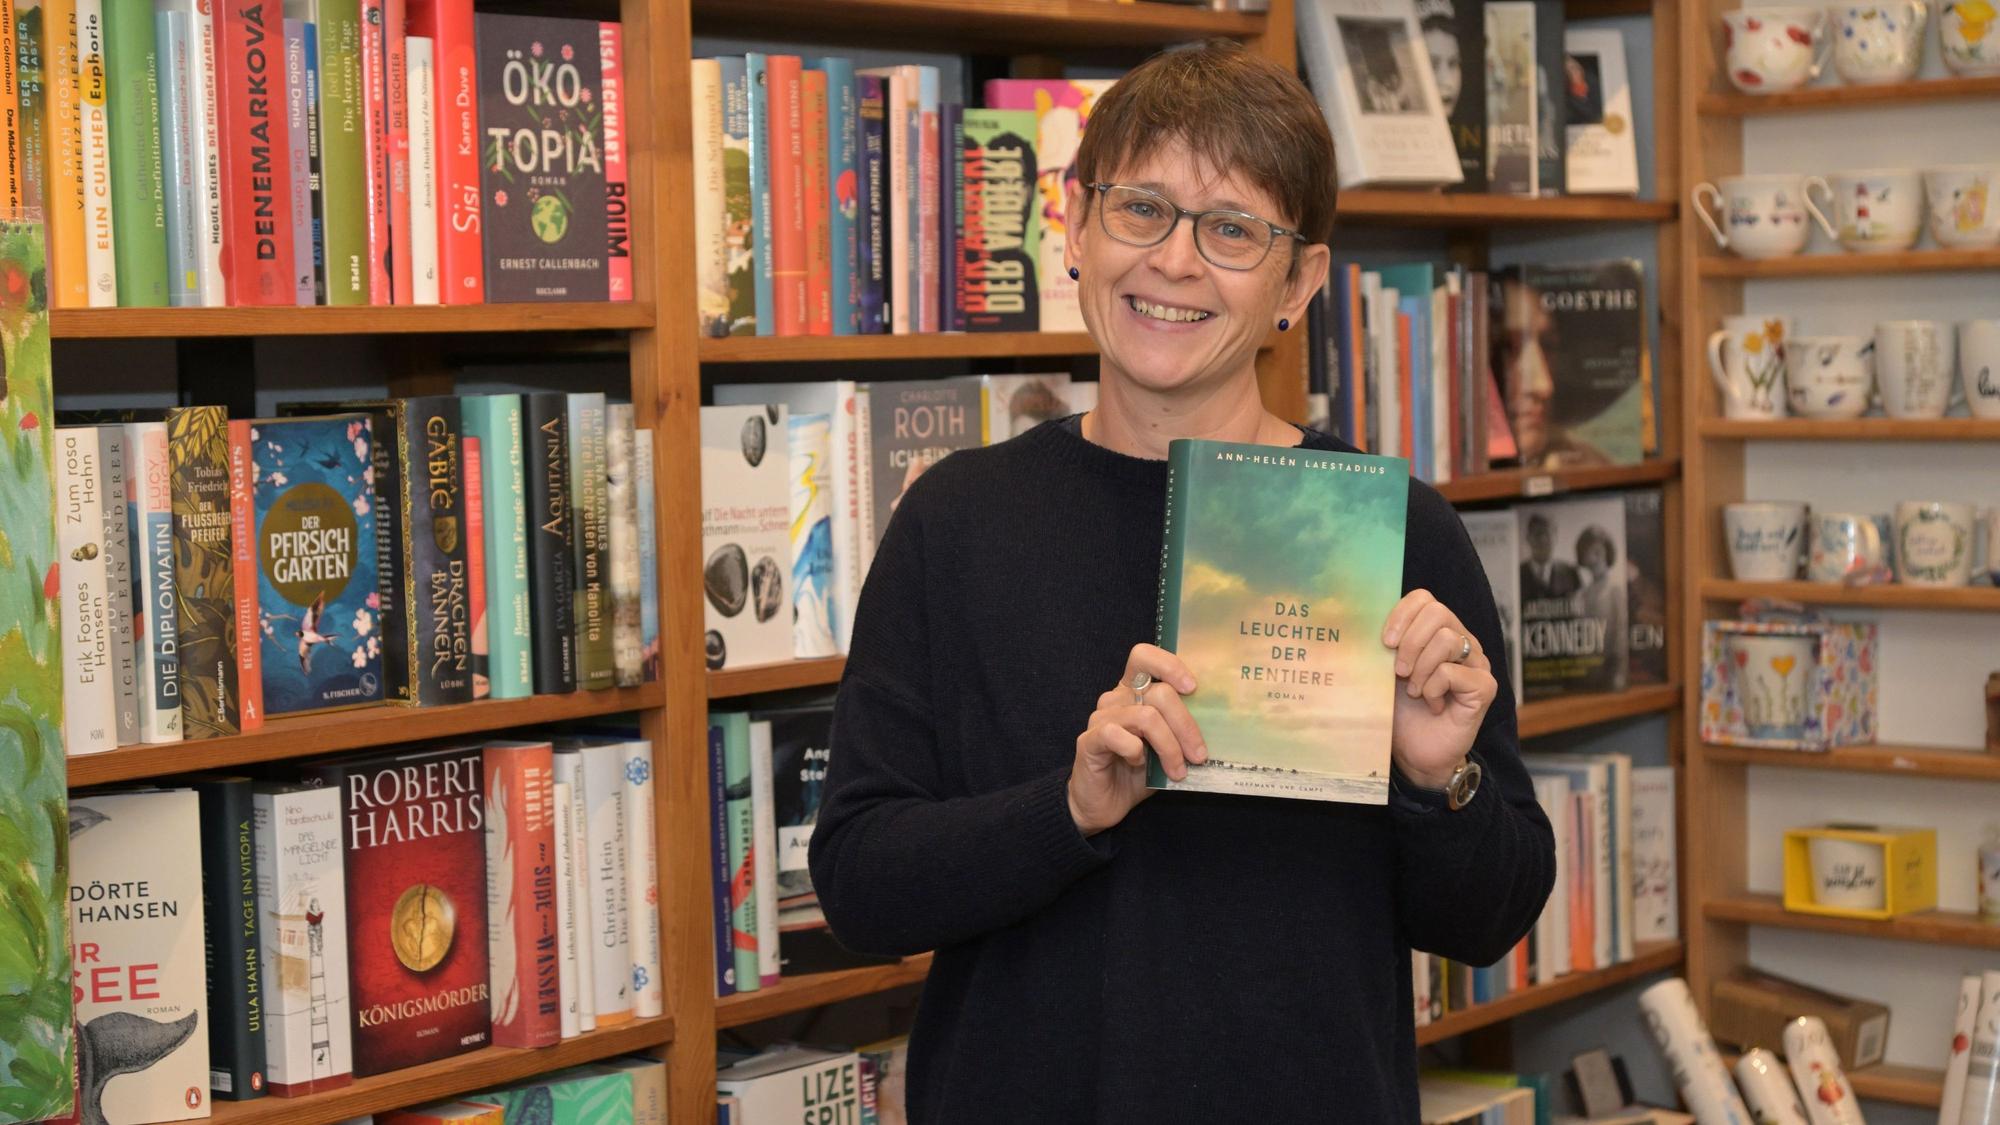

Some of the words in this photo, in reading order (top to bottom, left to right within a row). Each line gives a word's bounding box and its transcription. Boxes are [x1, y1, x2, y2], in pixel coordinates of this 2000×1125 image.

[19, 21, 30, 77] PAPIER
[69, 12, 80, 89] HERZEN
[85, 14, 102, 100] Euphorie
[176, 39, 187, 71] Herz
[203, 23, 214, 72] NARREN
[325, 19, 338, 69] Dicker
[340, 20, 352, 53] Tage
[599, 28, 616, 71] LISA
[30, 39, 40, 93] PALAST
[57, 45, 70, 119] CROSSAN
[146, 52, 157, 94] Glück
[289, 37, 300, 85] Nicola
[341, 56, 354, 105] letzten
[371, 31, 381, 102] GESICHTER
[391, 52, 403, 105] TOCHTER
[502, 49, 582, 107] ÖKO
[22, 81, 31, 107] DER
[205, 75, 215, 125] HEILIGEN
[326, 72, 339, 98] Joël
[456, 66, 471, 107] Duve
[788, 79, 801, 128] ÜBUNG
[6, 107, 14, 125] Das
[150, 97, 159, 123] von
[178, 74, 191, 155] synthetische
[290, 87, 302, 129] Denis
[342, 107, 355, 133] Die
[392, 107, 403, 129] DIE
[600, 78, 621, 164] ECKHART
[61, 127, 73, 177] SARAH
[91, 109, 106, 197] CULLHED
[206, 128, 216, 147] DIE
[239, 2, 277, 261] DENEMARKOVÁ
[457, 111, 473, 156] Karen
[488, 127, 602, 174] TOPIA
[790, 130, 802, 156] DIE
[25, 136, 33, 182] MIRANDA
[73, 103, 84, 211] VERHEIZTE
[150, 126, 162, 201] Definition
[182, 158, 192, 185] Das
[208, 154, 219, 199] DELIBES
[9, 174, 17, 192] mit
[309, 171, 320, 191] SIE
[375, 184, 384, 214] TOVE
[531, 175, 567, 186] ROMAN
[869, 159, 881, 212] APOTHEKE
[96, 206, 109, 250] ELIN
[155, 203, 164, 229] Die
[210, 202, 220, 244] MIGUEL
[451, 182, 480, 235] Sisi
[499, 258, 538, 270] ERNEST
[539, 258, 600, 270] CALLENBACH
[871, 213, 882, 281] VERSTECKTE
[350, 254, 360, 292] PIPER
[1542, 288, 1638, 313] GOETHE
[508, 408, 520, 467] Chemie
[581, 408, 594, 430] Die
[893, 405, 966, 440] ROTH
[64, 437, 79, 476] rosa
[426, 415, 454, 511] GABLÉ
[447, 432, 459, 497] REBECCA
[582, 435, 596, 464] drei
[593, 408, 607, 484] ALMUDENA
[889, 448, 920, 468] ICH
[1216, 451, 1297, 467] ANN-HELÉN
[1304, 460, 1387, 475] LAESTADIUS
[80, 454, 95, 504] Hahn
[147, 458, 162, 511] LUCY
[159, 438, 172, 511] FRICKE
[187, 480, 228, 493] Friedrich
[193, 465, 222, 479] Tobias
[231, 445, 249, 500] years
[510, 468, 520, 495] der
[540, 417, 564, 536] AQUITANIA
[846, 431, 858, 520] BEIFANG
[65, 482, 83, 525] Zum
[110, 442, 125, 548] ANDERER
[199, 501, 212, 511] DER
[583, 469, 598, 549] Hochzeiten
[713, 508, 729, 521] Die
[730, 507, 756, 520] Nacht
[1164, 468, 1176, 534] RENTIERE
[190, 527, 227, 543] PFEIFER
[233, 504, 250, 562] panic
[301, 516, 319, 530] DER
[511, 496, 527, 544] Frage
[597, 487, 608, 552] GRANDES
[100, 509, 115, 588] FOSSE
[270, 527, 349, 558] PFIRSICH
[513, 545, 526, 580] Eine
[1161, 543, 1169, 569] DER
[116, 560, 128, 599] EIN
[273, 553, 349, 584] GARTEN
[585, 553, 598, 578] von
[155, 522, 176, 655] DIPLOMATIN
[1274, 602, 1310, 618] DAS
[76, 582, 93, 645] Fosnes
[91, 596, 107, 667] Hansen
[103, 590, 118, 634] JON
[119, 610, 131, 646] IST
[239, 597, 251, 641] FRIZZELL
[430, 569, 451, 680] BANNER
[449, 560, 467, 672] DRACHEN
[587, 581, 602, 642] Manolita
[1239, 621, 1341, 643] LEUCHTEN
[241, 644, 253, 669] NELL
[1271, 646, 1307, 662] DER
[1523, 616, 1608, 659] KENNEDY
[78, 651, 95, 684] Erik
[121, 658, 134, 697] ICH
[162, 663, 178, 697] DIE
[1240, 665, 1335, 686] RENTIERE
[214, 660, 226, 723] C.Bertelsmann
[1267, 691, 1305, 700] ROMAN
[347, 755, 481, 812] ROBERT
[523, 766, 542, 832] HARRIS
[542, 767, 553, 827] NATHAN
[1234, 780, 1276, 790] HOFFMANN
[1280, 784, 1296, 792] UND
[1298, 785, 1325, 793] CAMPE
[349, 793, 482, 850] HARRIS
[611, 790, 624, 842] Strand
[239, 820, 252, 877] VITOPIA
[600, 840, 613, 882] Hein
[616, 846, 625, 872] am
[70, 880, 150, 902] DÖRTE
[241, 878, 254, 896] IN
[617, 873, 628, 912] Frau
[79, 900, 179, 924] HANSEN
[243, 899, 255, 937] TAGE
[602, 887, 617, 949] Christa
[618, 915, 629, 946] Die
[71, 963, 161, 1005] SEE
[245, 948, 257, 995] HAHN
[536, 934, 557, 1016] WASSER
[146, 1005, 182, 1015] ROMAN
[247, 996, 261, 1032] ULLA
[358, 982, 489, 1028] KÖNIGSMÖRDER
[802, 1063, 854, 1108] LIZE
